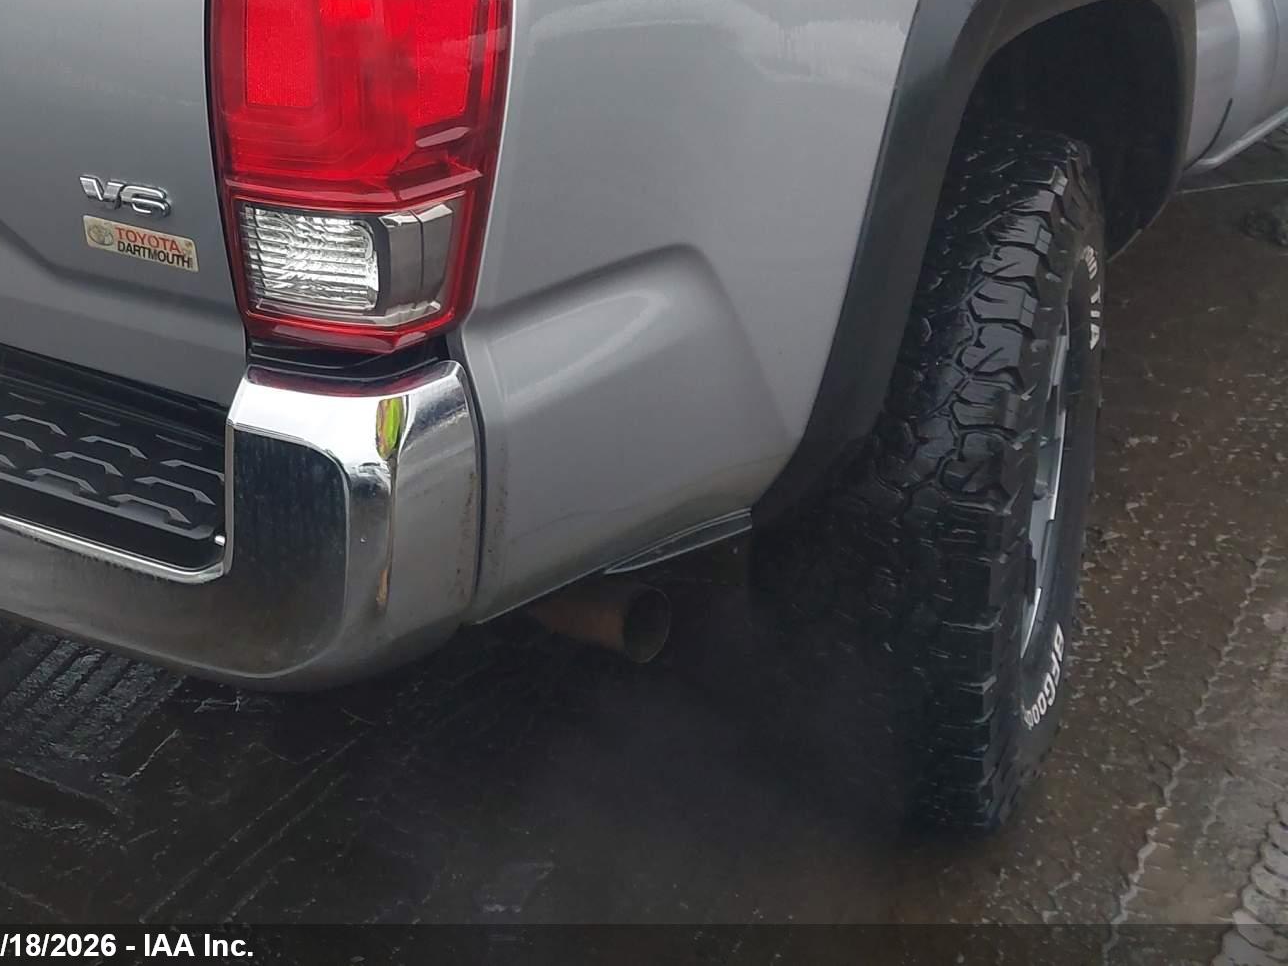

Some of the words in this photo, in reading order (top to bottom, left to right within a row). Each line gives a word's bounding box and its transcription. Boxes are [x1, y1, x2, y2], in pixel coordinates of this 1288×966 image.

[78, 174, 172, 218] V6
[114, 226, 182, 255] TOYOTA
[116, 240, 193, 269] DARTMOUTH
